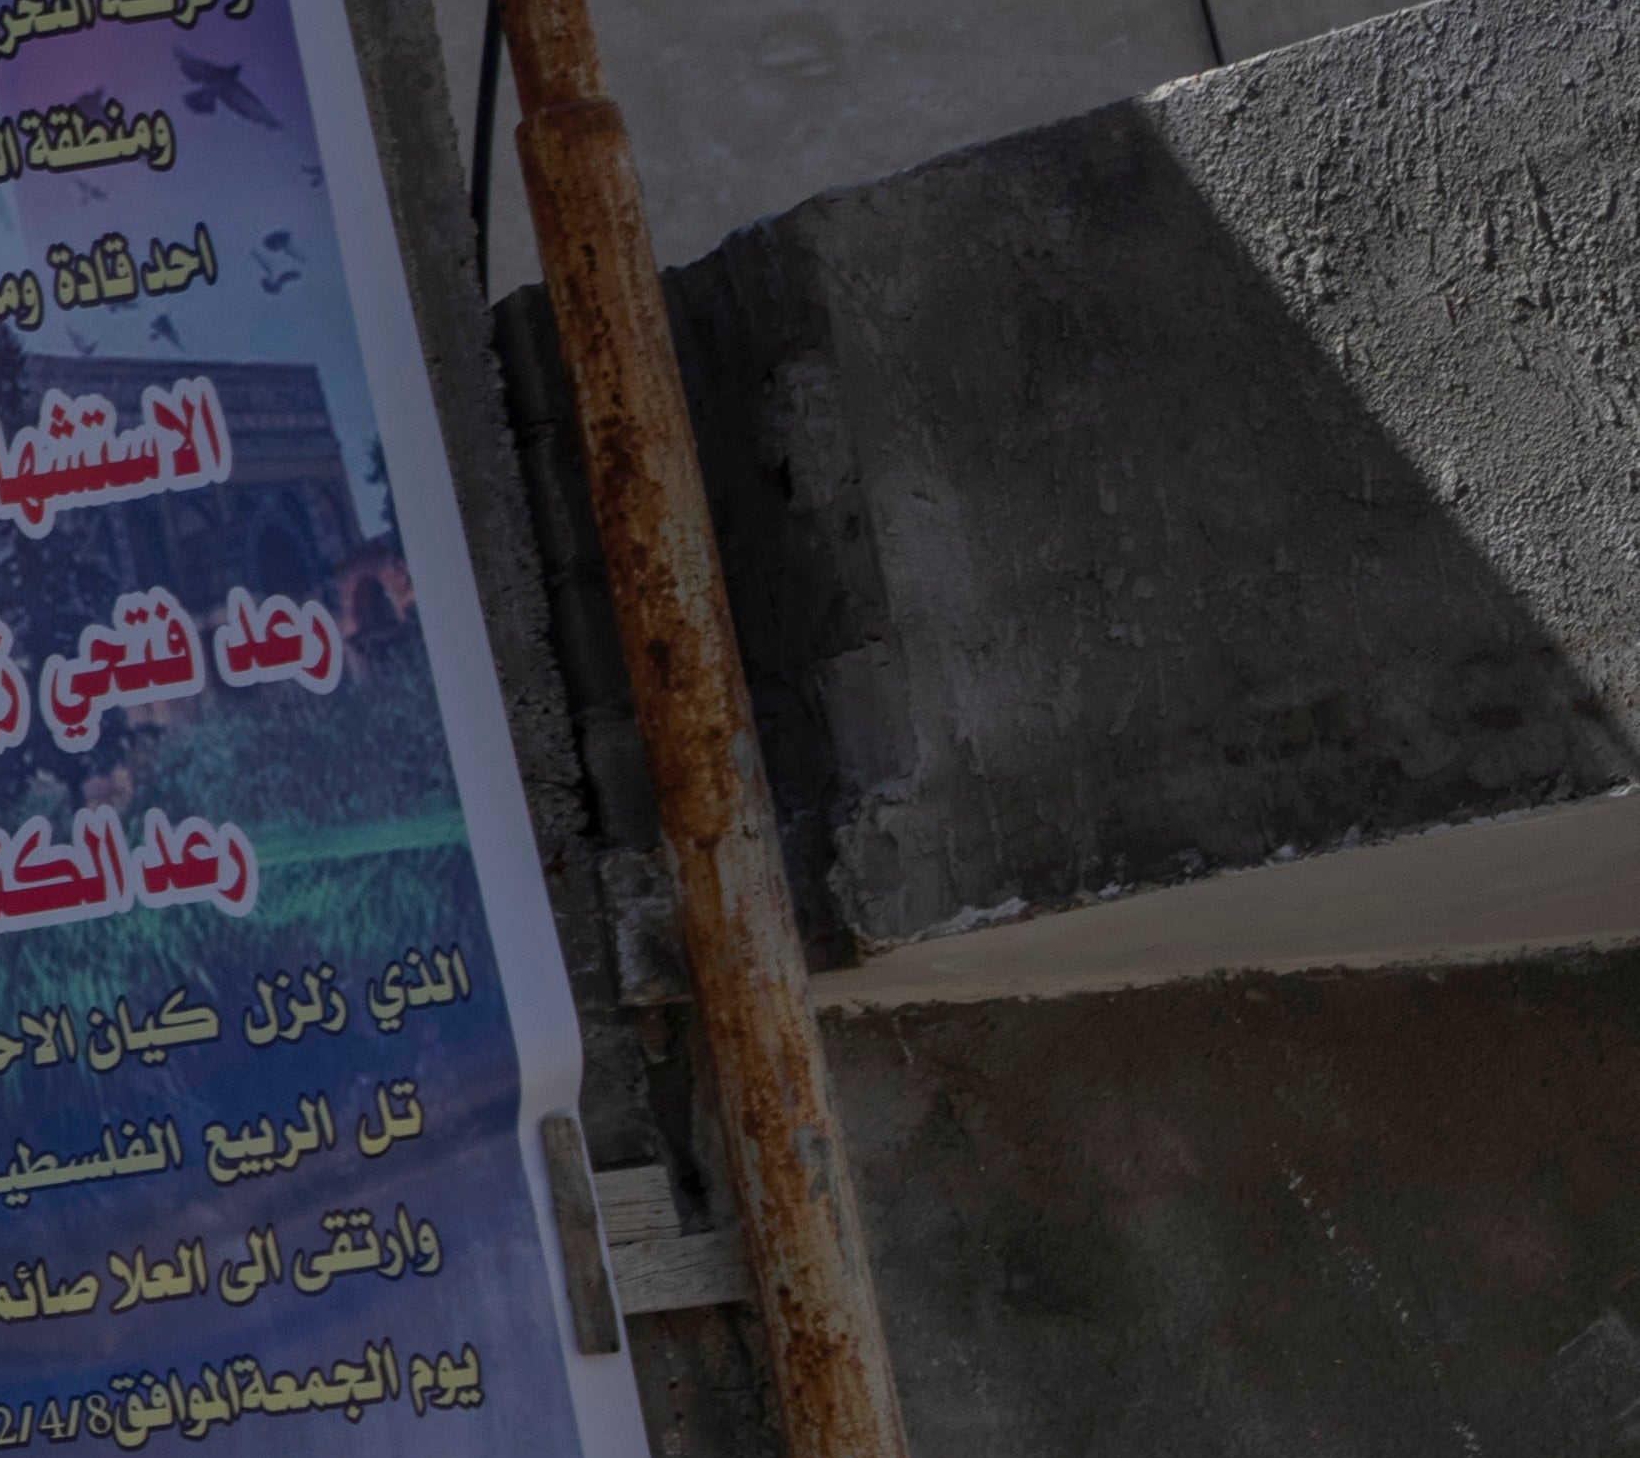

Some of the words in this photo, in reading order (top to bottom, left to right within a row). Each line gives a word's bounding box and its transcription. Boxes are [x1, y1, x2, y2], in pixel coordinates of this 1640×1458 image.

[19, 98, 175, 170] ومنطقة
[49, 230, 136, 309] قادة
[142, 224, 216, 298] احد
[49, 600, 196, 740] فتحي
[224, 599, 334, 682] رعد
[140, 820, 249, 905] رعد
[242, 964, 347, 1042] زلزل
[366, 944, 469, 1031] الذي
[87, 986, 219, 1071] كيان
[203, 1091, 334, 1183] الربيع
[357, 1079, 424, 1158] تل
[108, 1239, 208, 1312] العلا
[216, 1224, 282, 1304] الى
[289, 1203, 444, 1284] وارتقى
[409, 1343, 482, 1416] يوم
